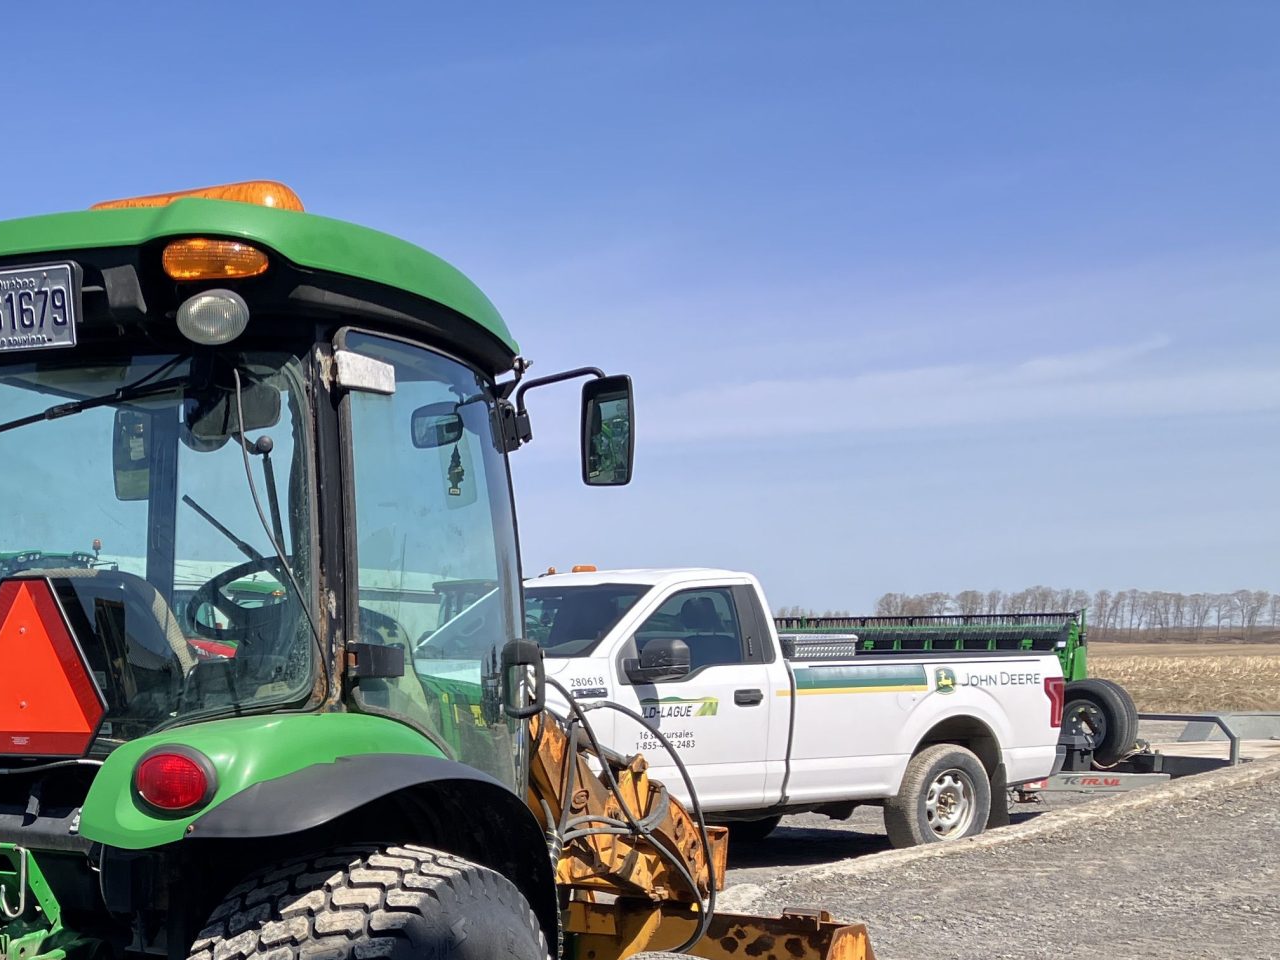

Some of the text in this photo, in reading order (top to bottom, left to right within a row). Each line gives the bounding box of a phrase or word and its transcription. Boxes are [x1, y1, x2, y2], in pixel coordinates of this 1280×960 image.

[570, 676, 604, 687] 280618
[962, 671, 1041, 687] JOHN DEERE
[639, 729, 694, 740] 16 scursales
[635, 740, 696, 751] 1-855-45-2483
